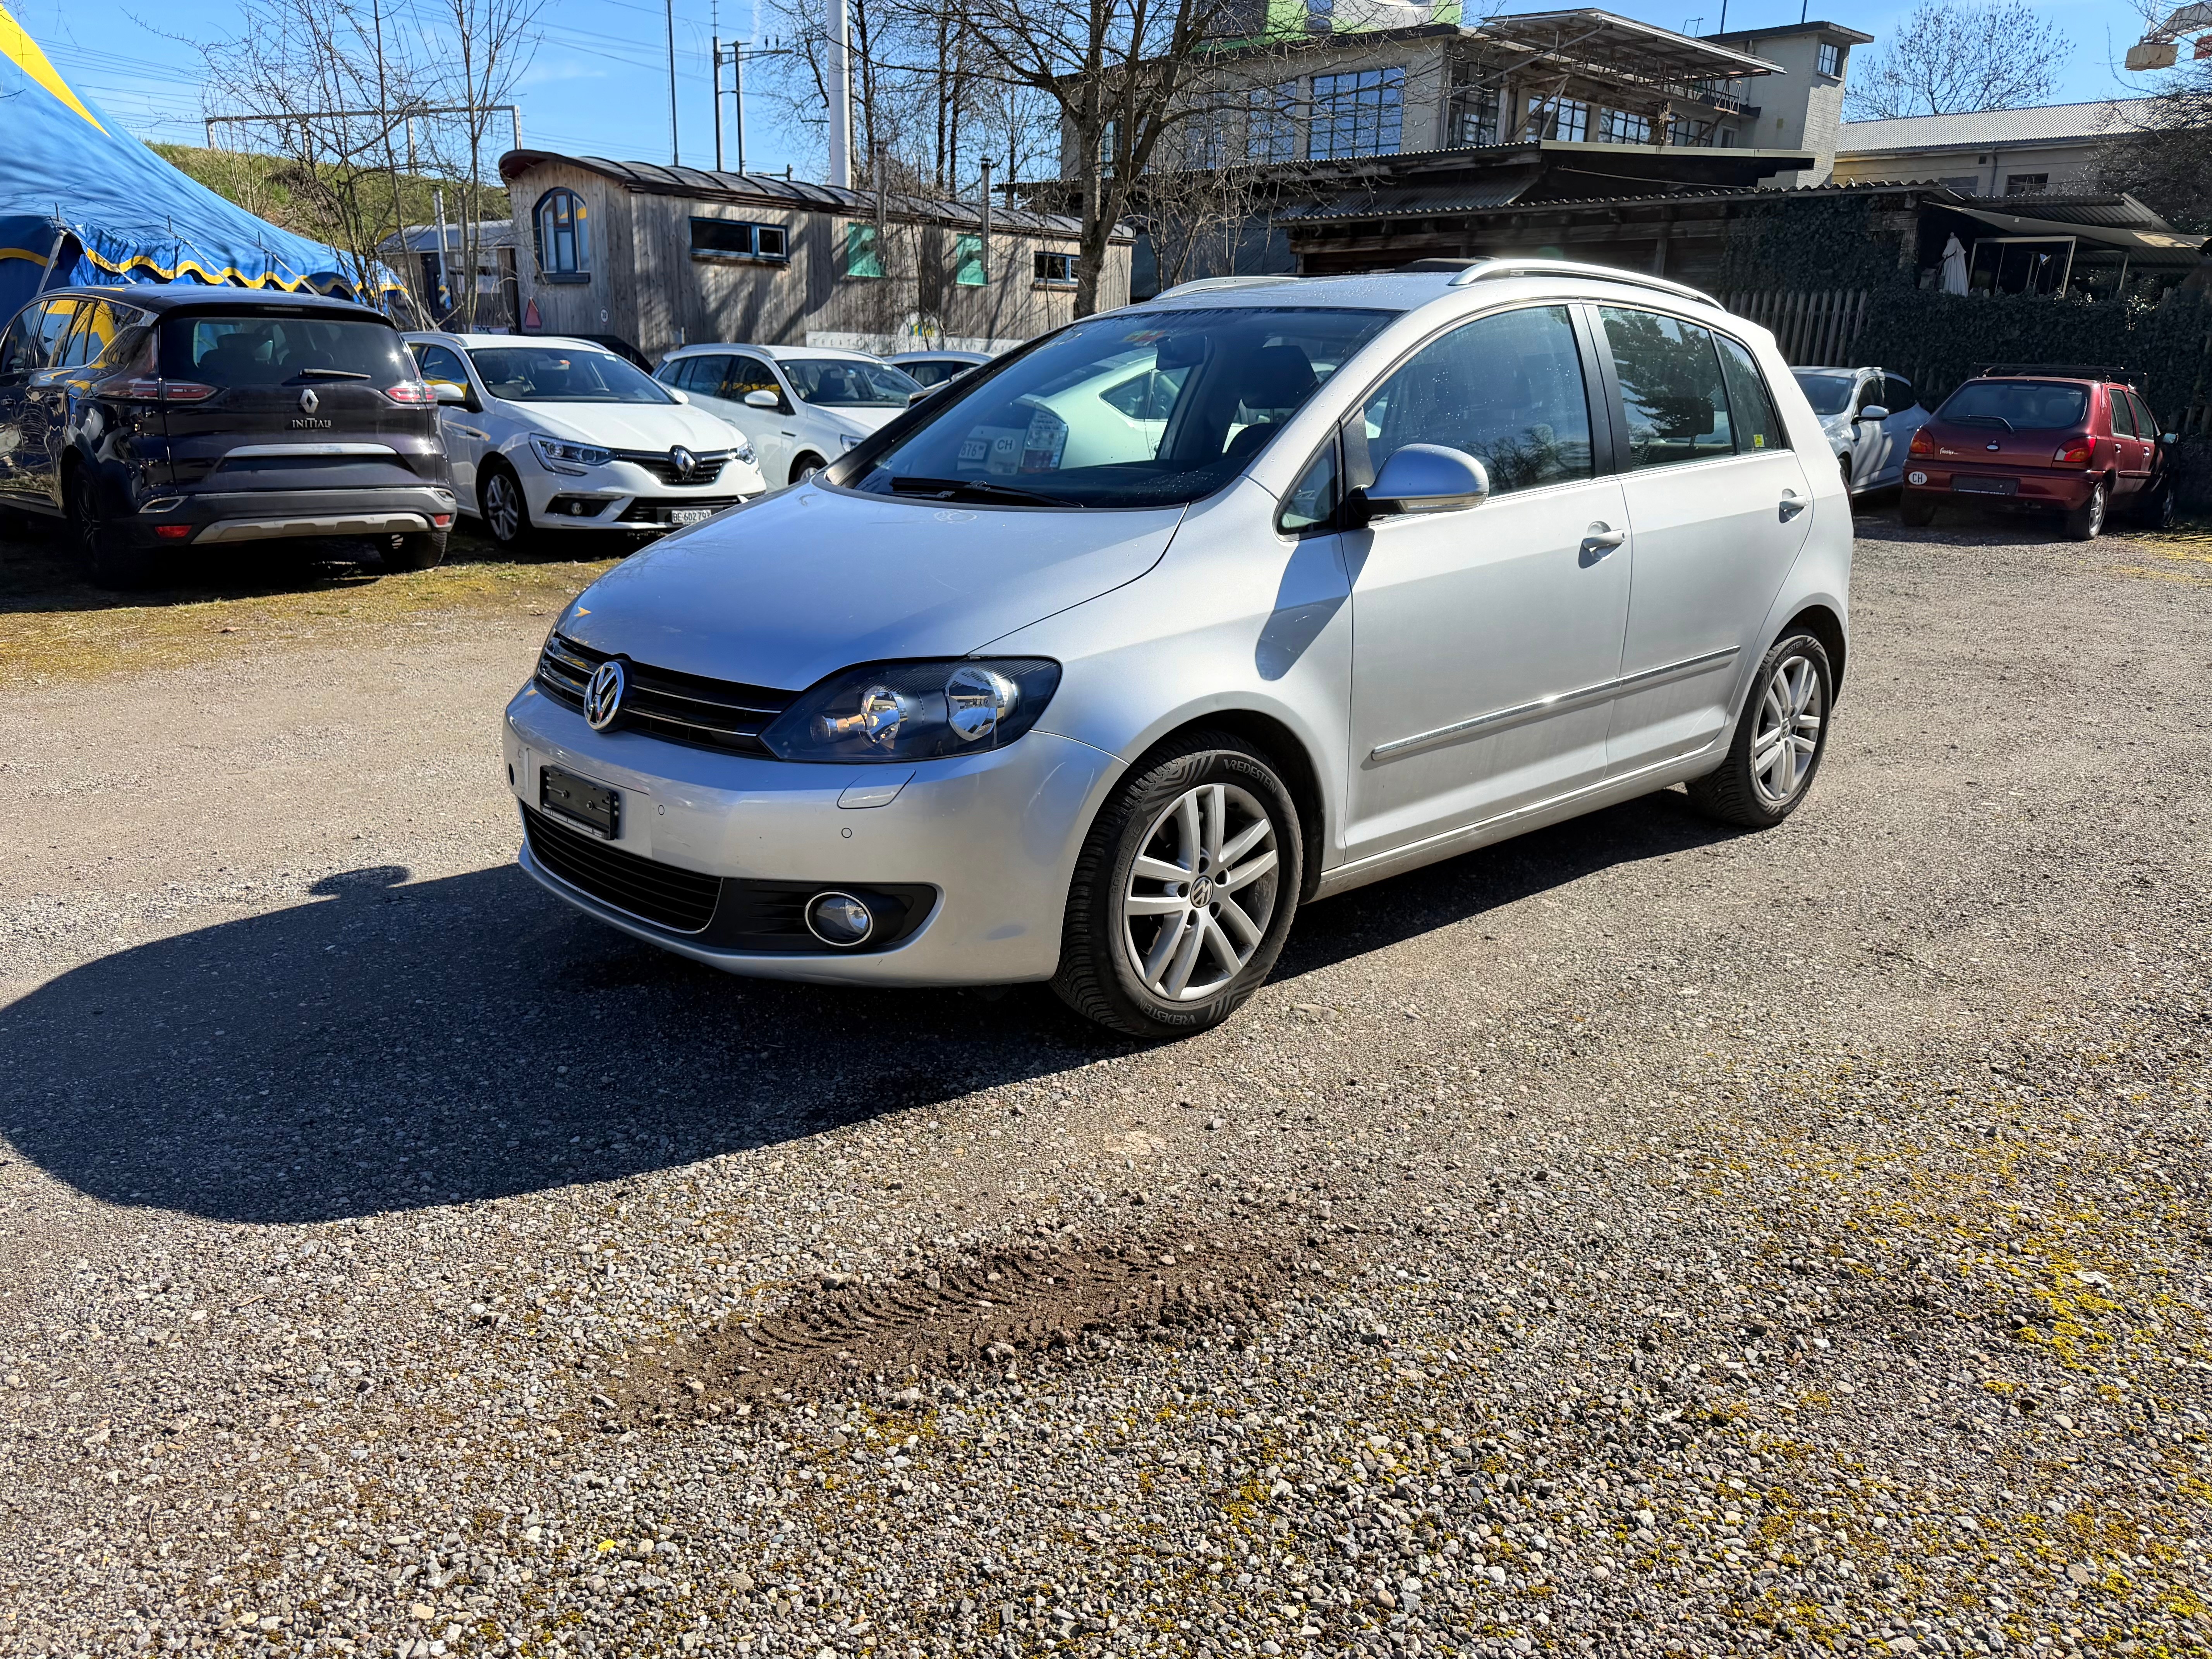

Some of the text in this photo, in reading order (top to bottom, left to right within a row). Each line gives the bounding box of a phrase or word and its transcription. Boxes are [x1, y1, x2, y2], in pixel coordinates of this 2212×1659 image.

[997, 439, 1013, 450] CH
[1912, 473, 1923, 483] CH
[1223, 759, 1277, 794] VREDESTEIN
[1137, 998, 1197, 1025] VREDESTEIN
